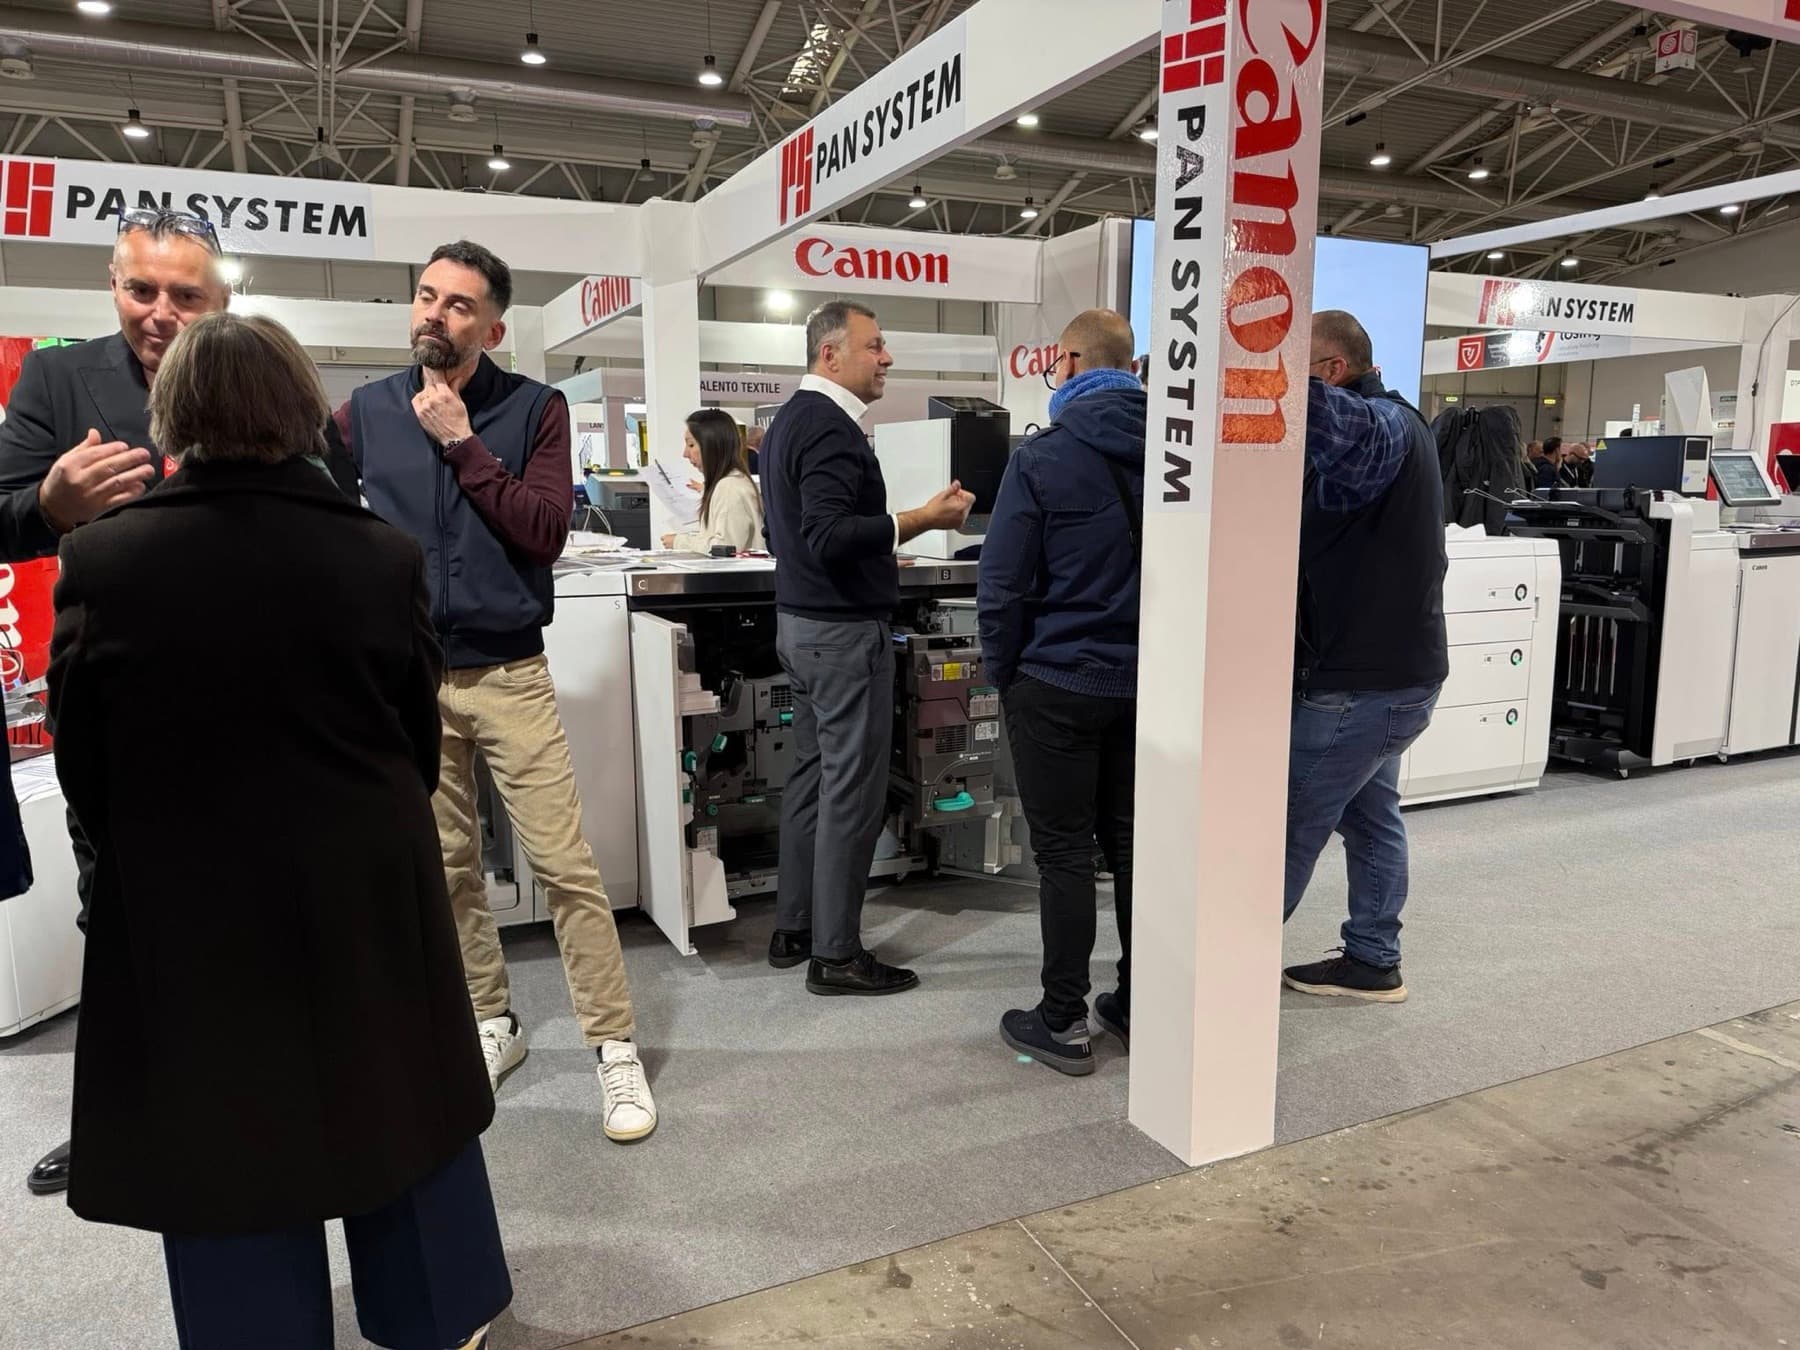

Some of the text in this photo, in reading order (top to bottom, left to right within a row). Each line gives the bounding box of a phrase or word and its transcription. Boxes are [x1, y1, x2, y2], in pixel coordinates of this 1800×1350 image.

[816, 53, 961, 184] PAN SYSTEM
[187, 192, 368, 237] SYSTEM
[795, 237, 949, 284] Canon
[581, 276, 631, 327] Canon
[1163, 104, 1206, 502] PAN SYSTEM
[1564, 297, 1634, 324] SYSTEM
[741, 382, 781, 394] TEXTILE
